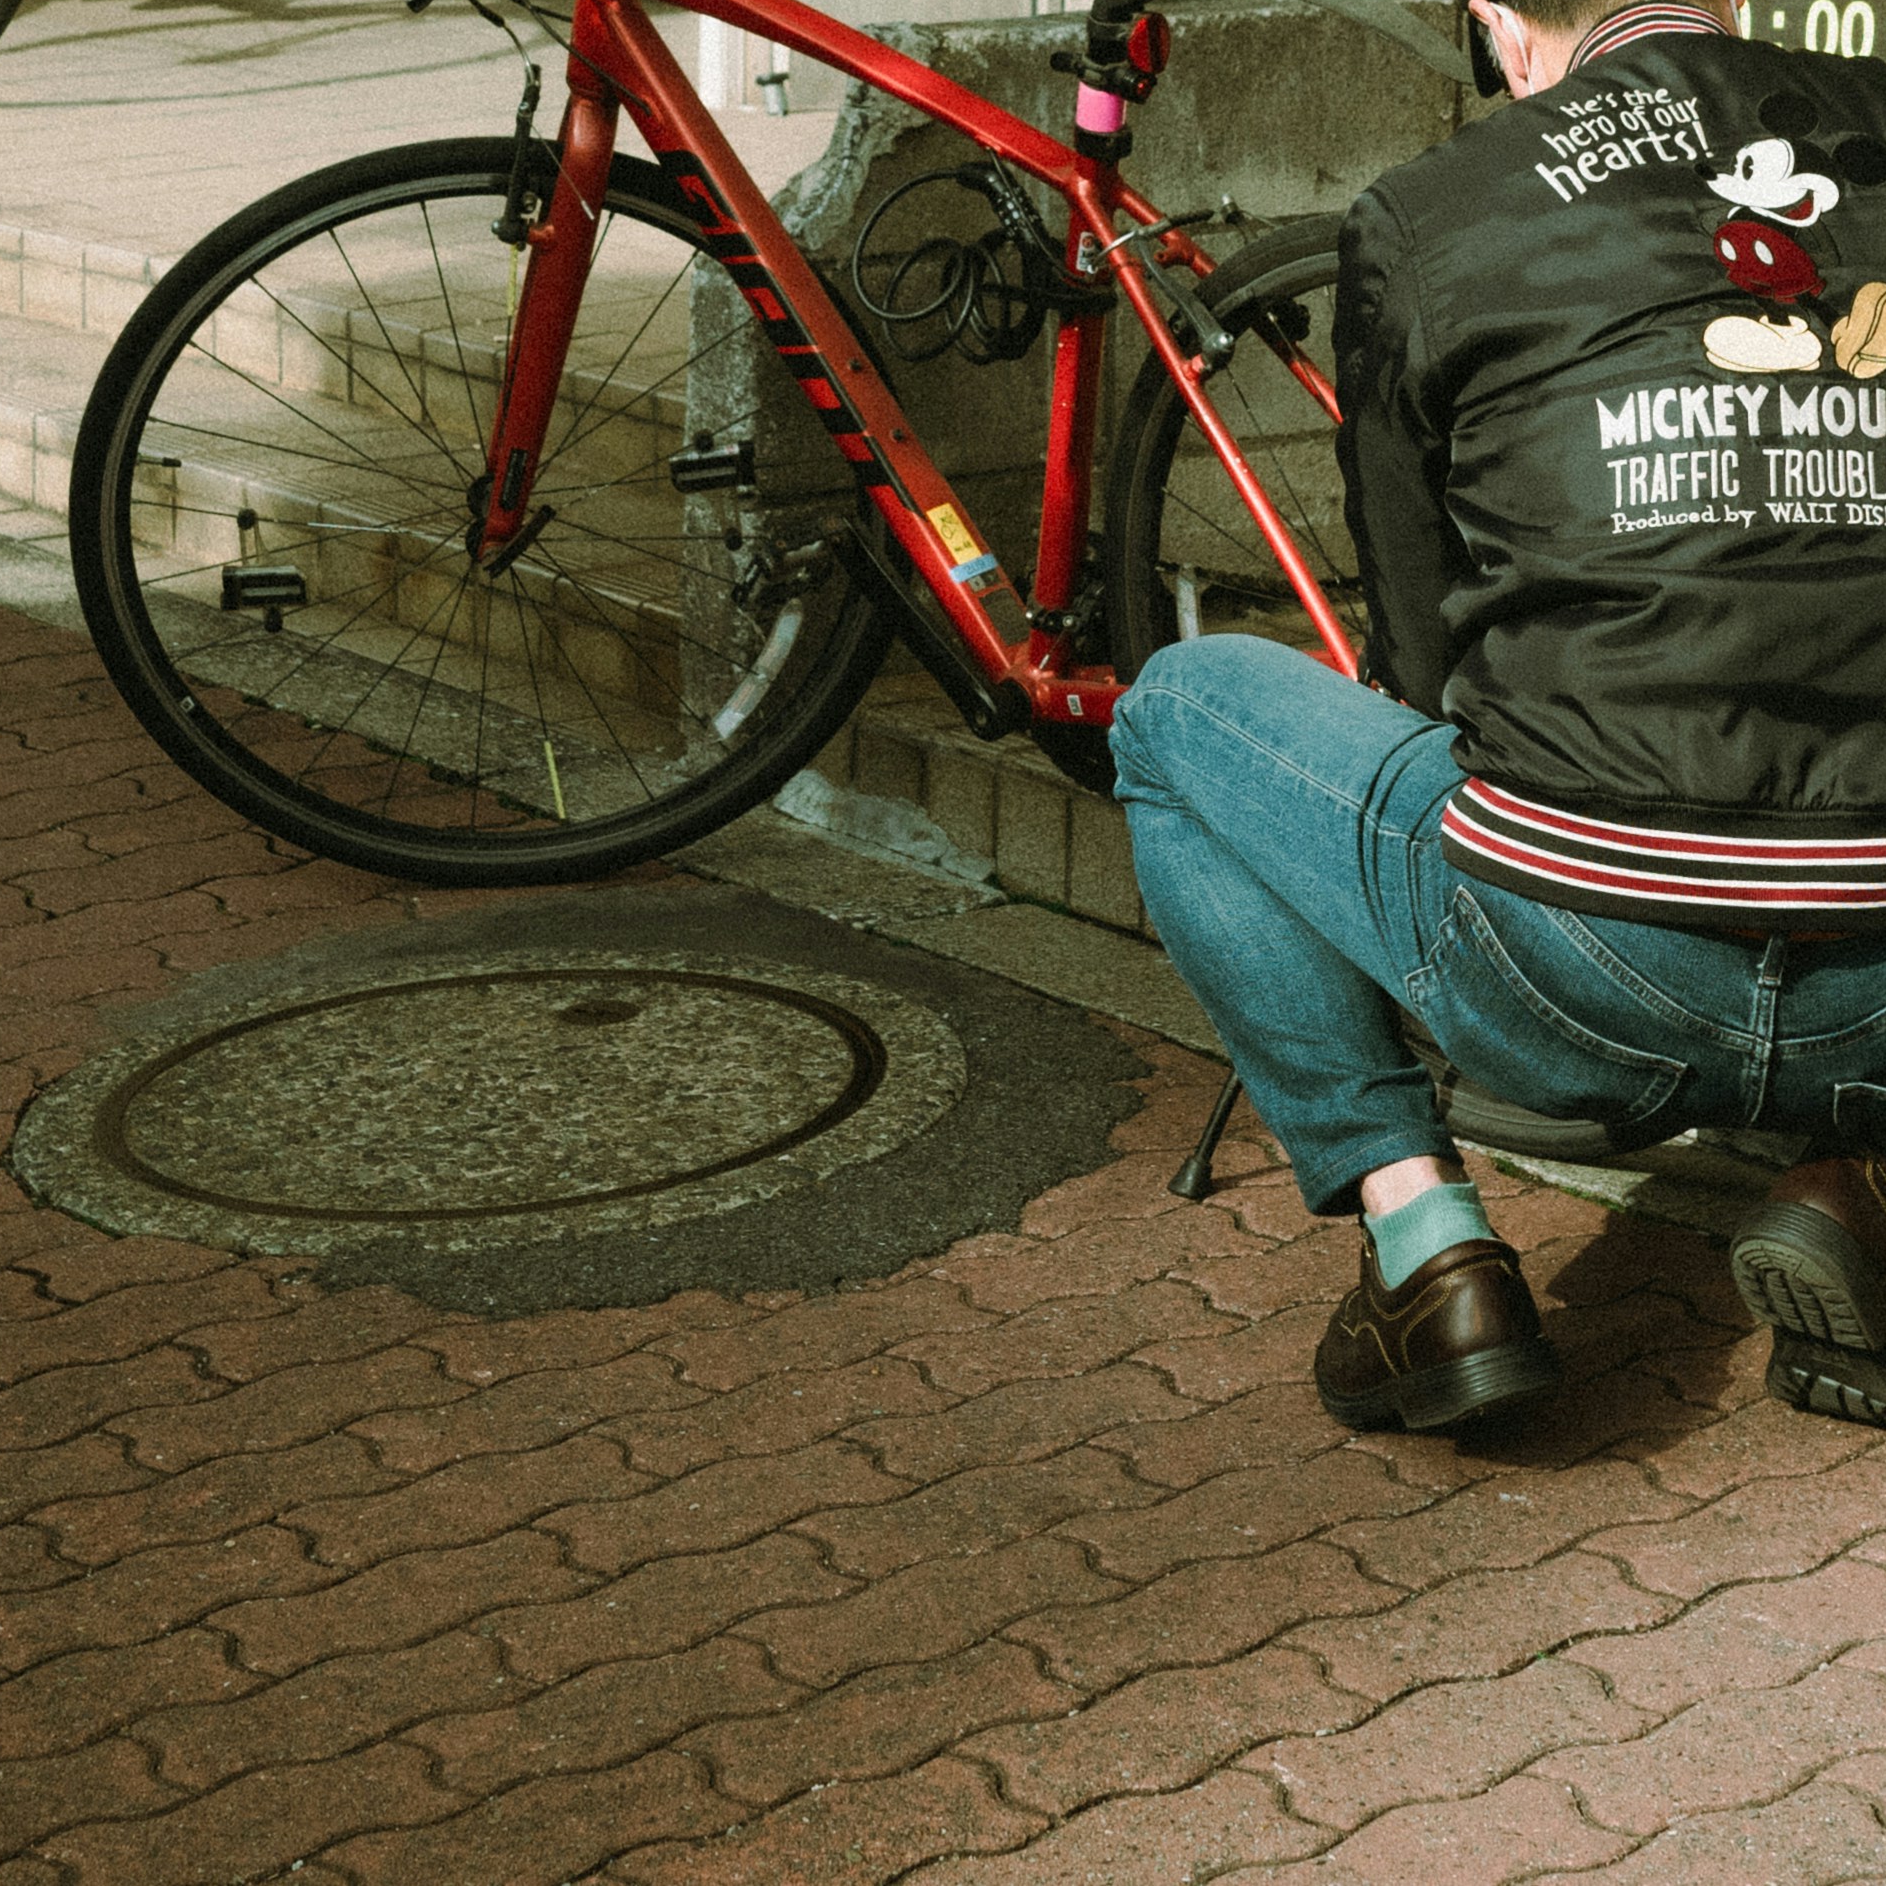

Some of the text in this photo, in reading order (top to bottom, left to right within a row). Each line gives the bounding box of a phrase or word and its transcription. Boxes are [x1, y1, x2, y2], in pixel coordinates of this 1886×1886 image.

[1541, 97, 1700, 159] hero of our
[1559, 88, 1672, 118] He's the
[1534, 120, 1714, 203] hearts!
[660, 150, 928, 522] GIANT
[1595, 384, 1770, 450] MICKEY
[1607, 449, 1741, 509] TRAFFIC
[1611, 505, 1722, 535] Produced
[1723, 504, 1757, 529] by
[1765, 502, 1838, 525] WALT
